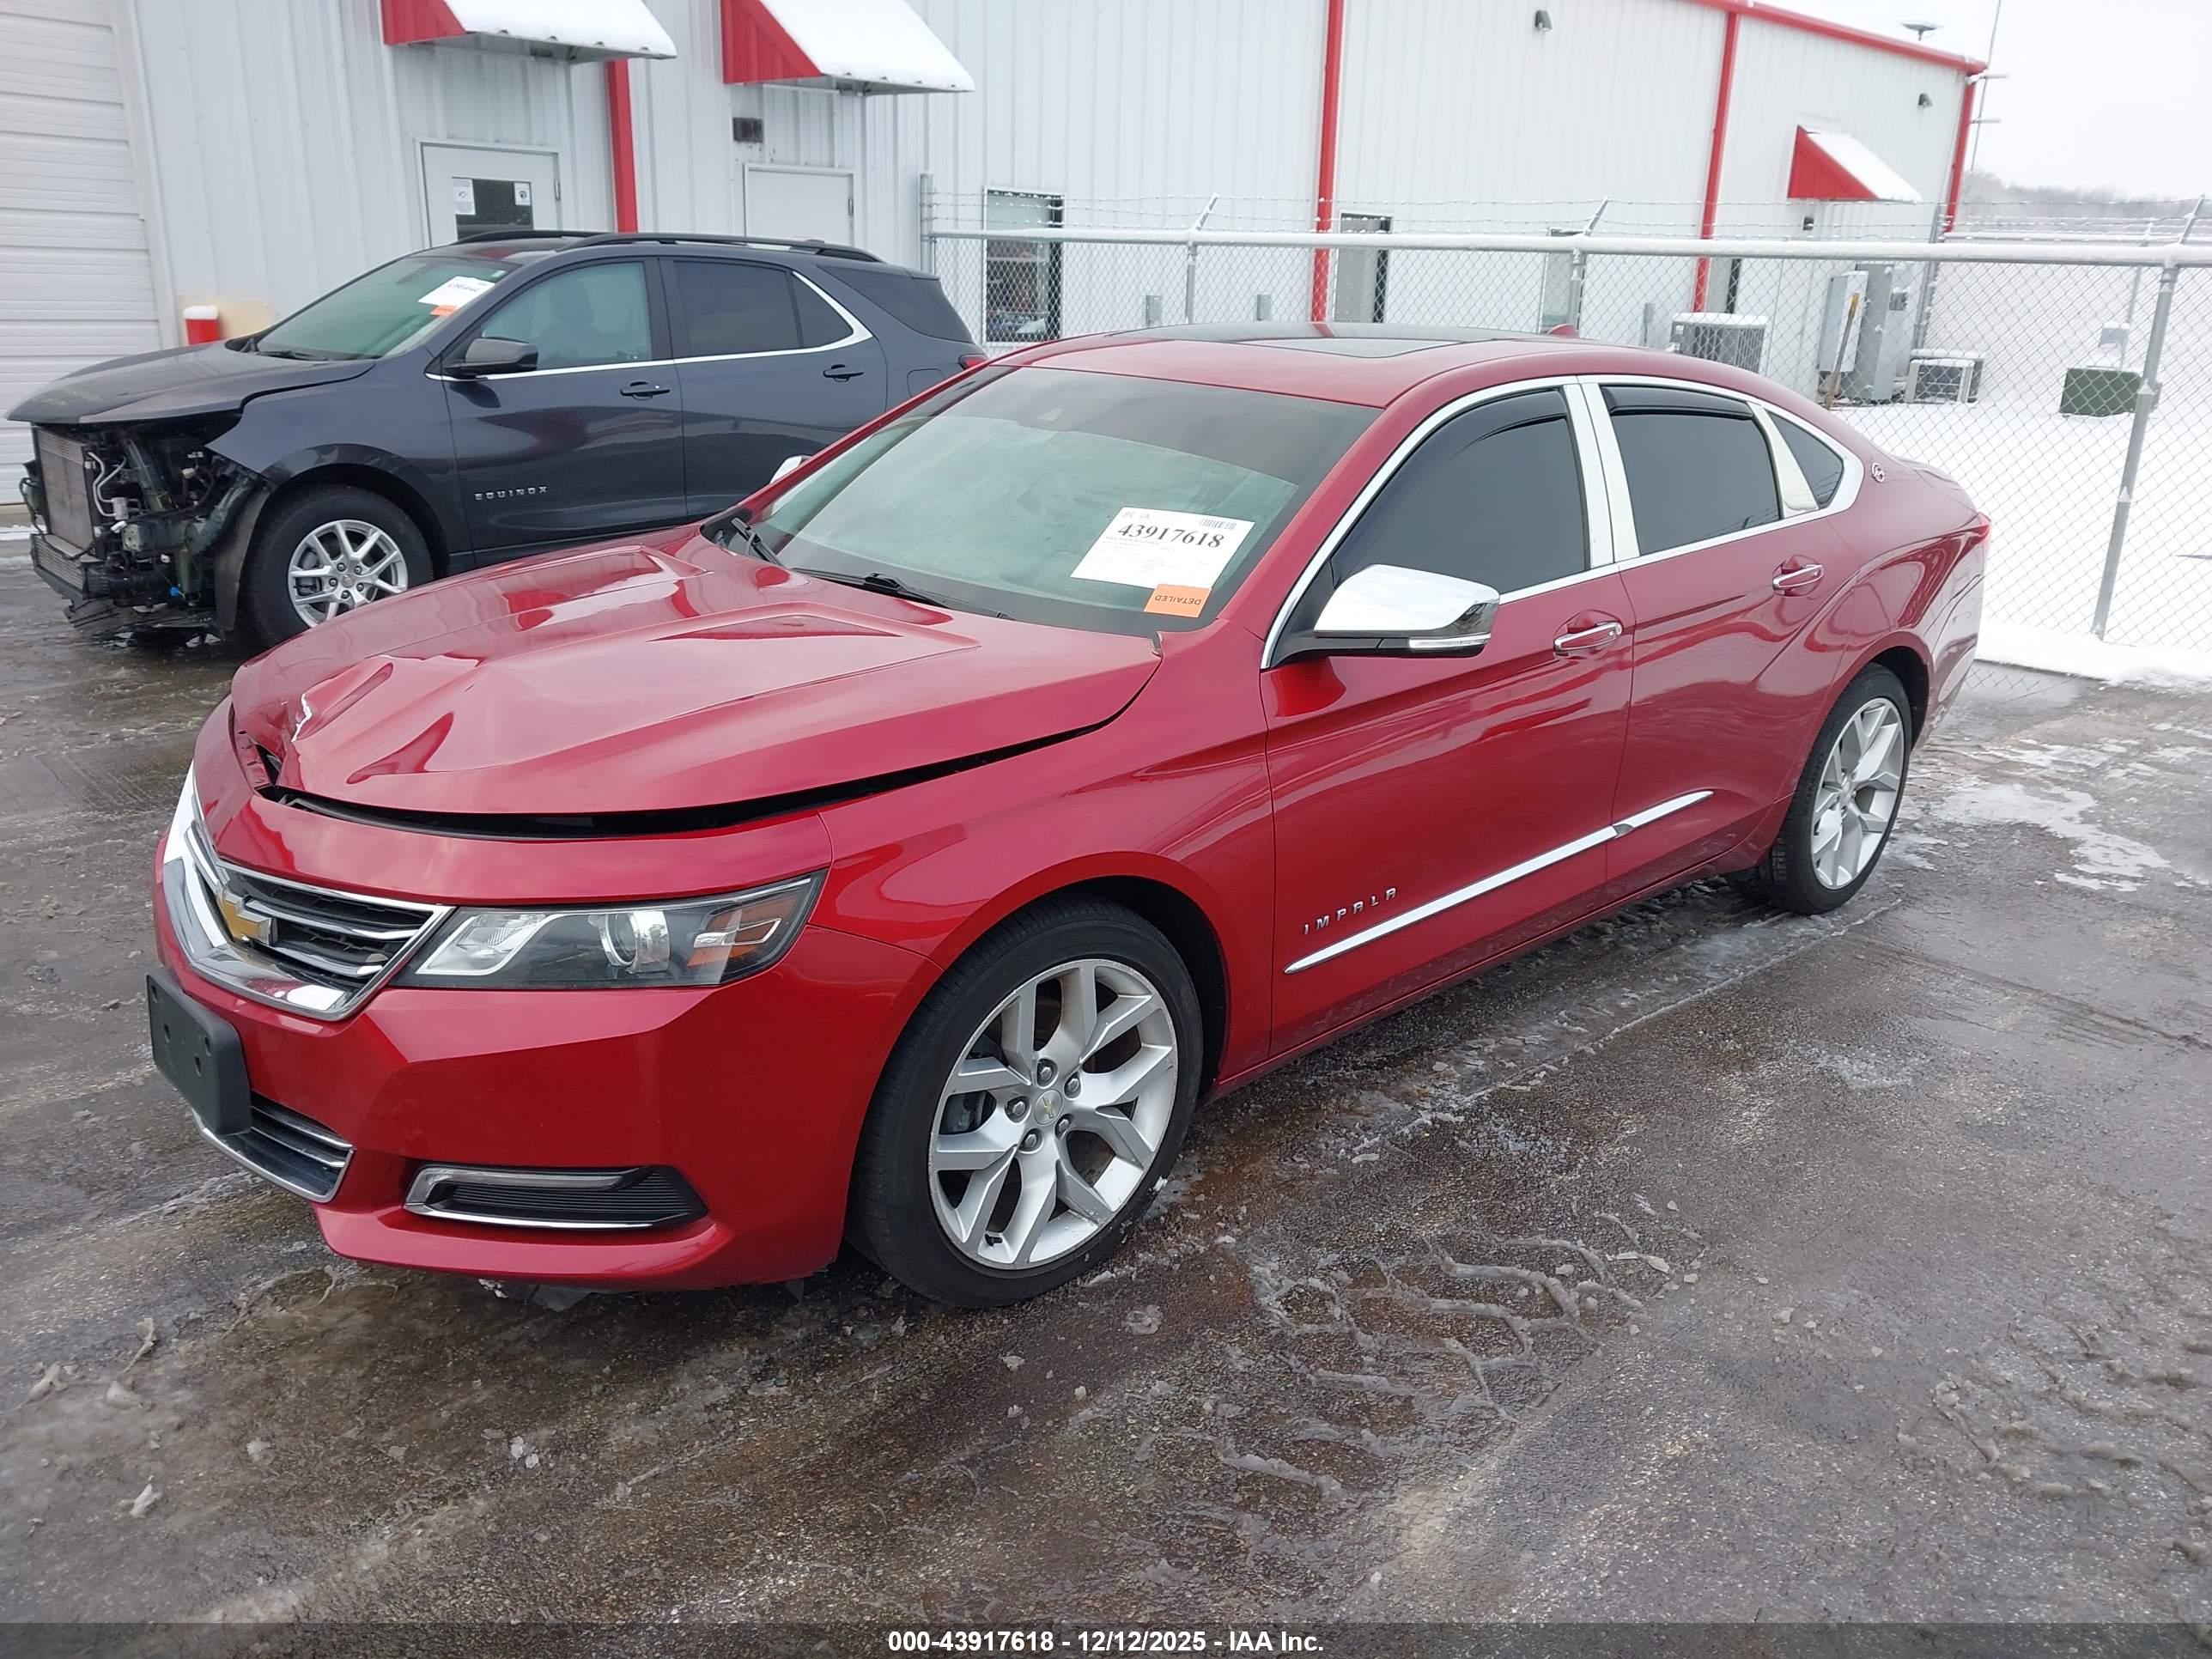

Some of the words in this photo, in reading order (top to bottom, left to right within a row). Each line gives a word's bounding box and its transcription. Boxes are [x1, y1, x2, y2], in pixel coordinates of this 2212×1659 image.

[474, 485, 547, 500] EQUINOX
[1117, 523, 1225, 549] 43917618
[1154, 594, 1202, 605] DETAILED
[1303, 887, 1396, 935] IMPALA
